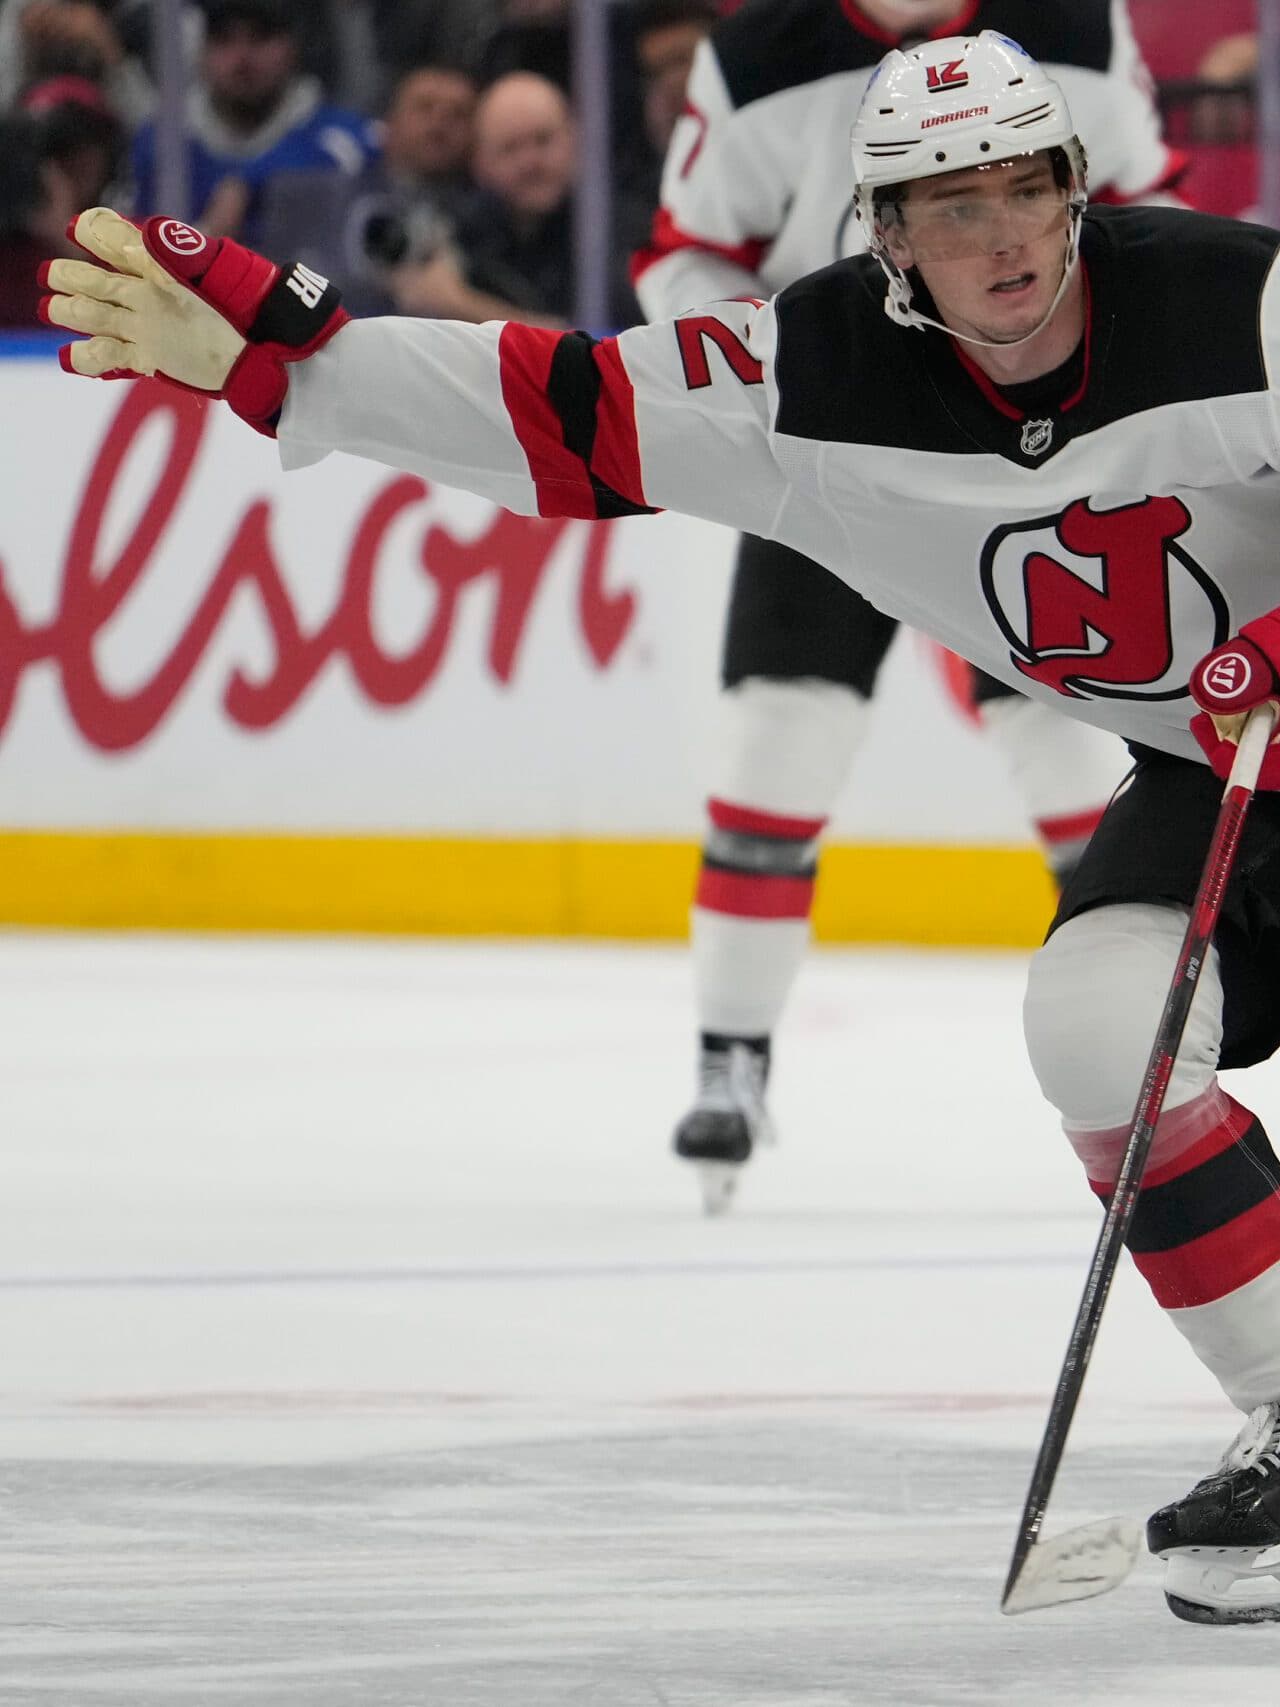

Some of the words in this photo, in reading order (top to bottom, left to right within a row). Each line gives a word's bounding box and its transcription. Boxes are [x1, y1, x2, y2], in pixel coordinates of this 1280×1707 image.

[926, 58, 969, 87] 12
[920, 105, 989, 129] WARRIOR
[0, 377, 637, 754] lson
